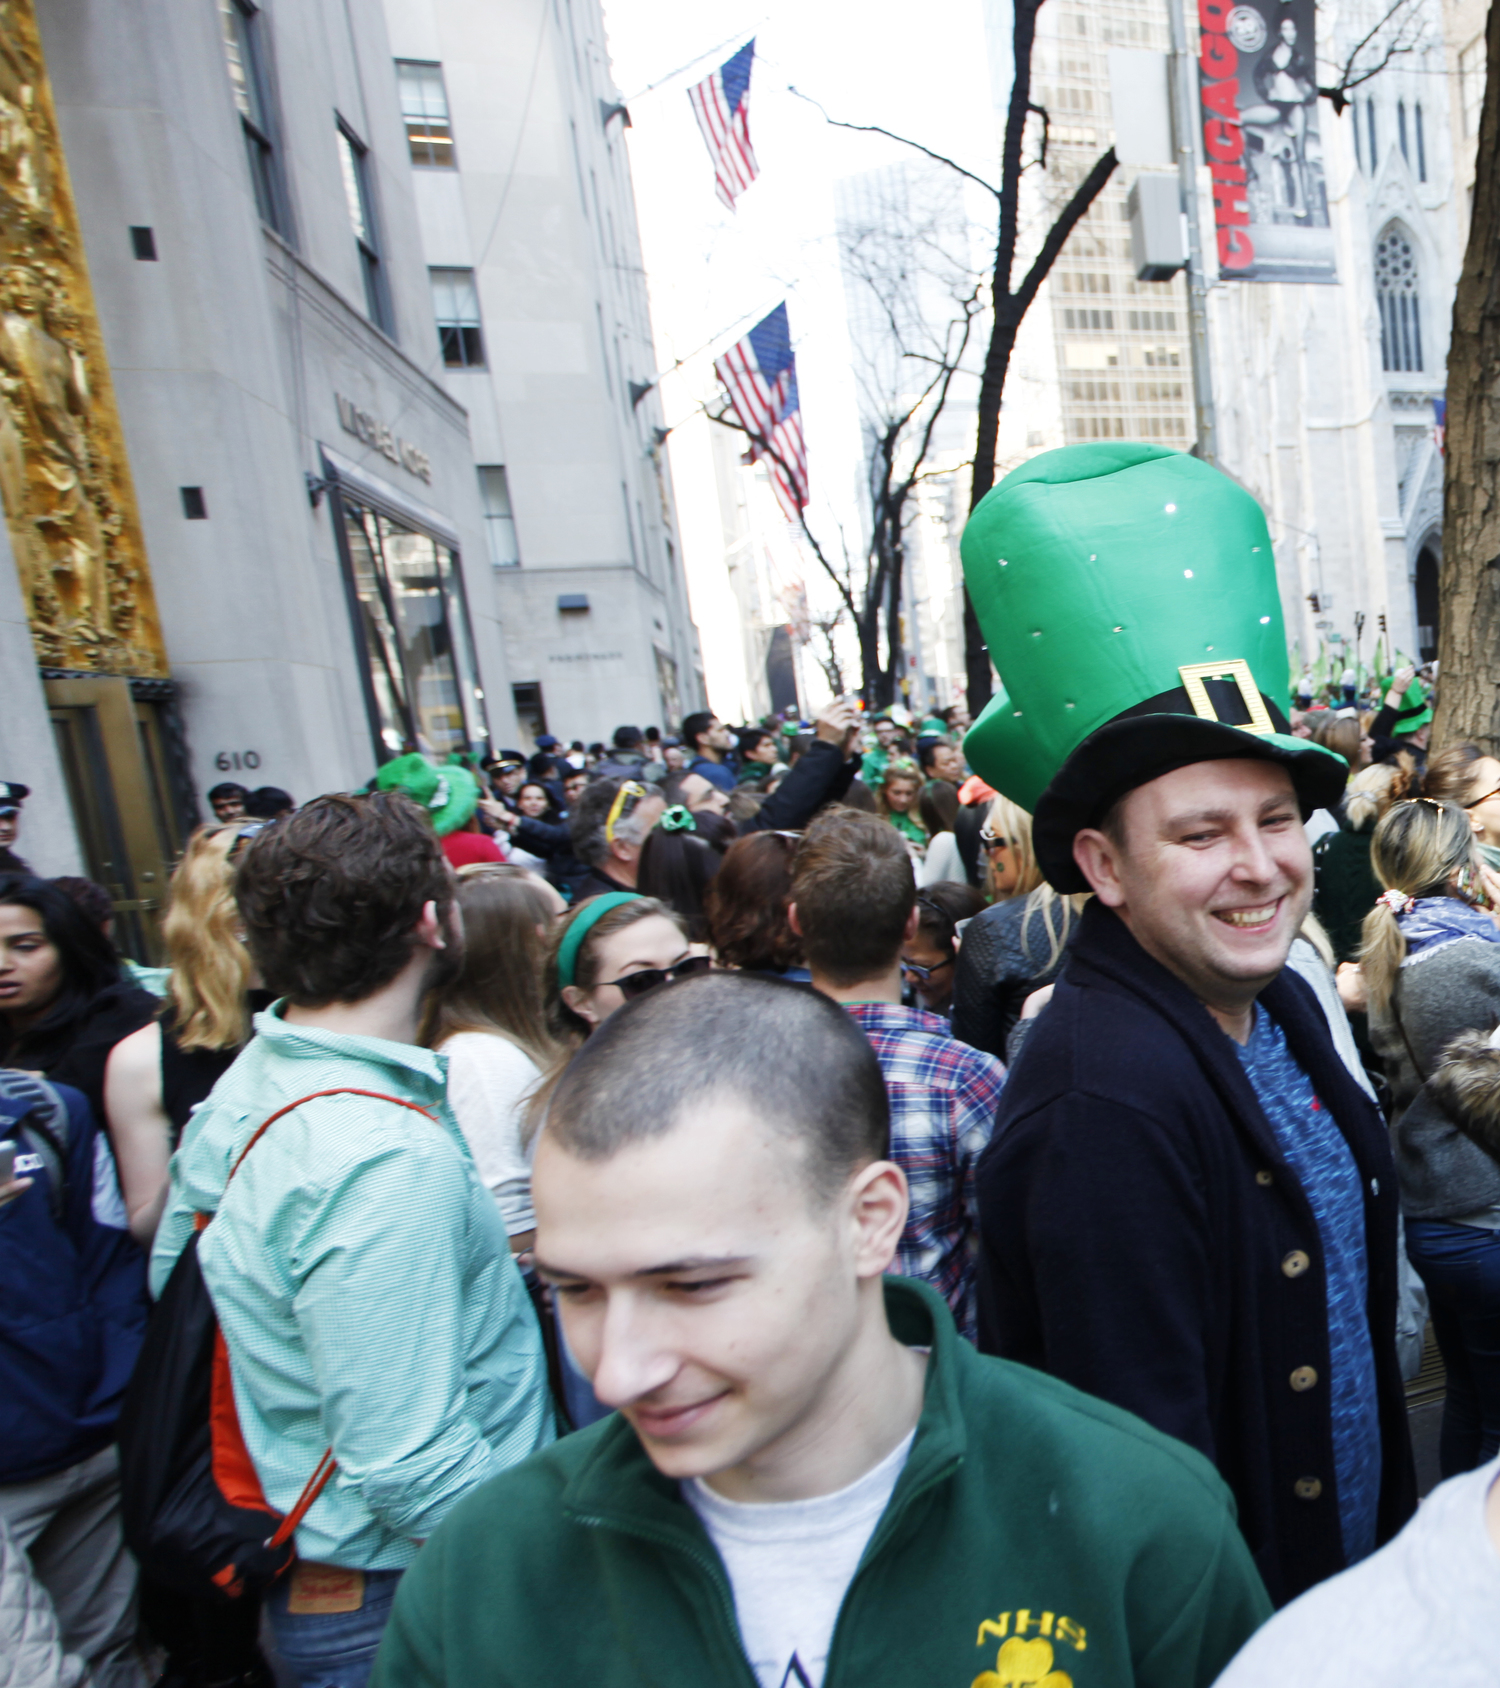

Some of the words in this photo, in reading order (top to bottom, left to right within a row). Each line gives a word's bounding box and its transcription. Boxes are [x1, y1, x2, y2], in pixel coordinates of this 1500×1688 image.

[1198, 0, 1255, 270] CHICAGO
[215, 750, 261, 772] 610
[976, 1608, 1087, 1651] NHS
